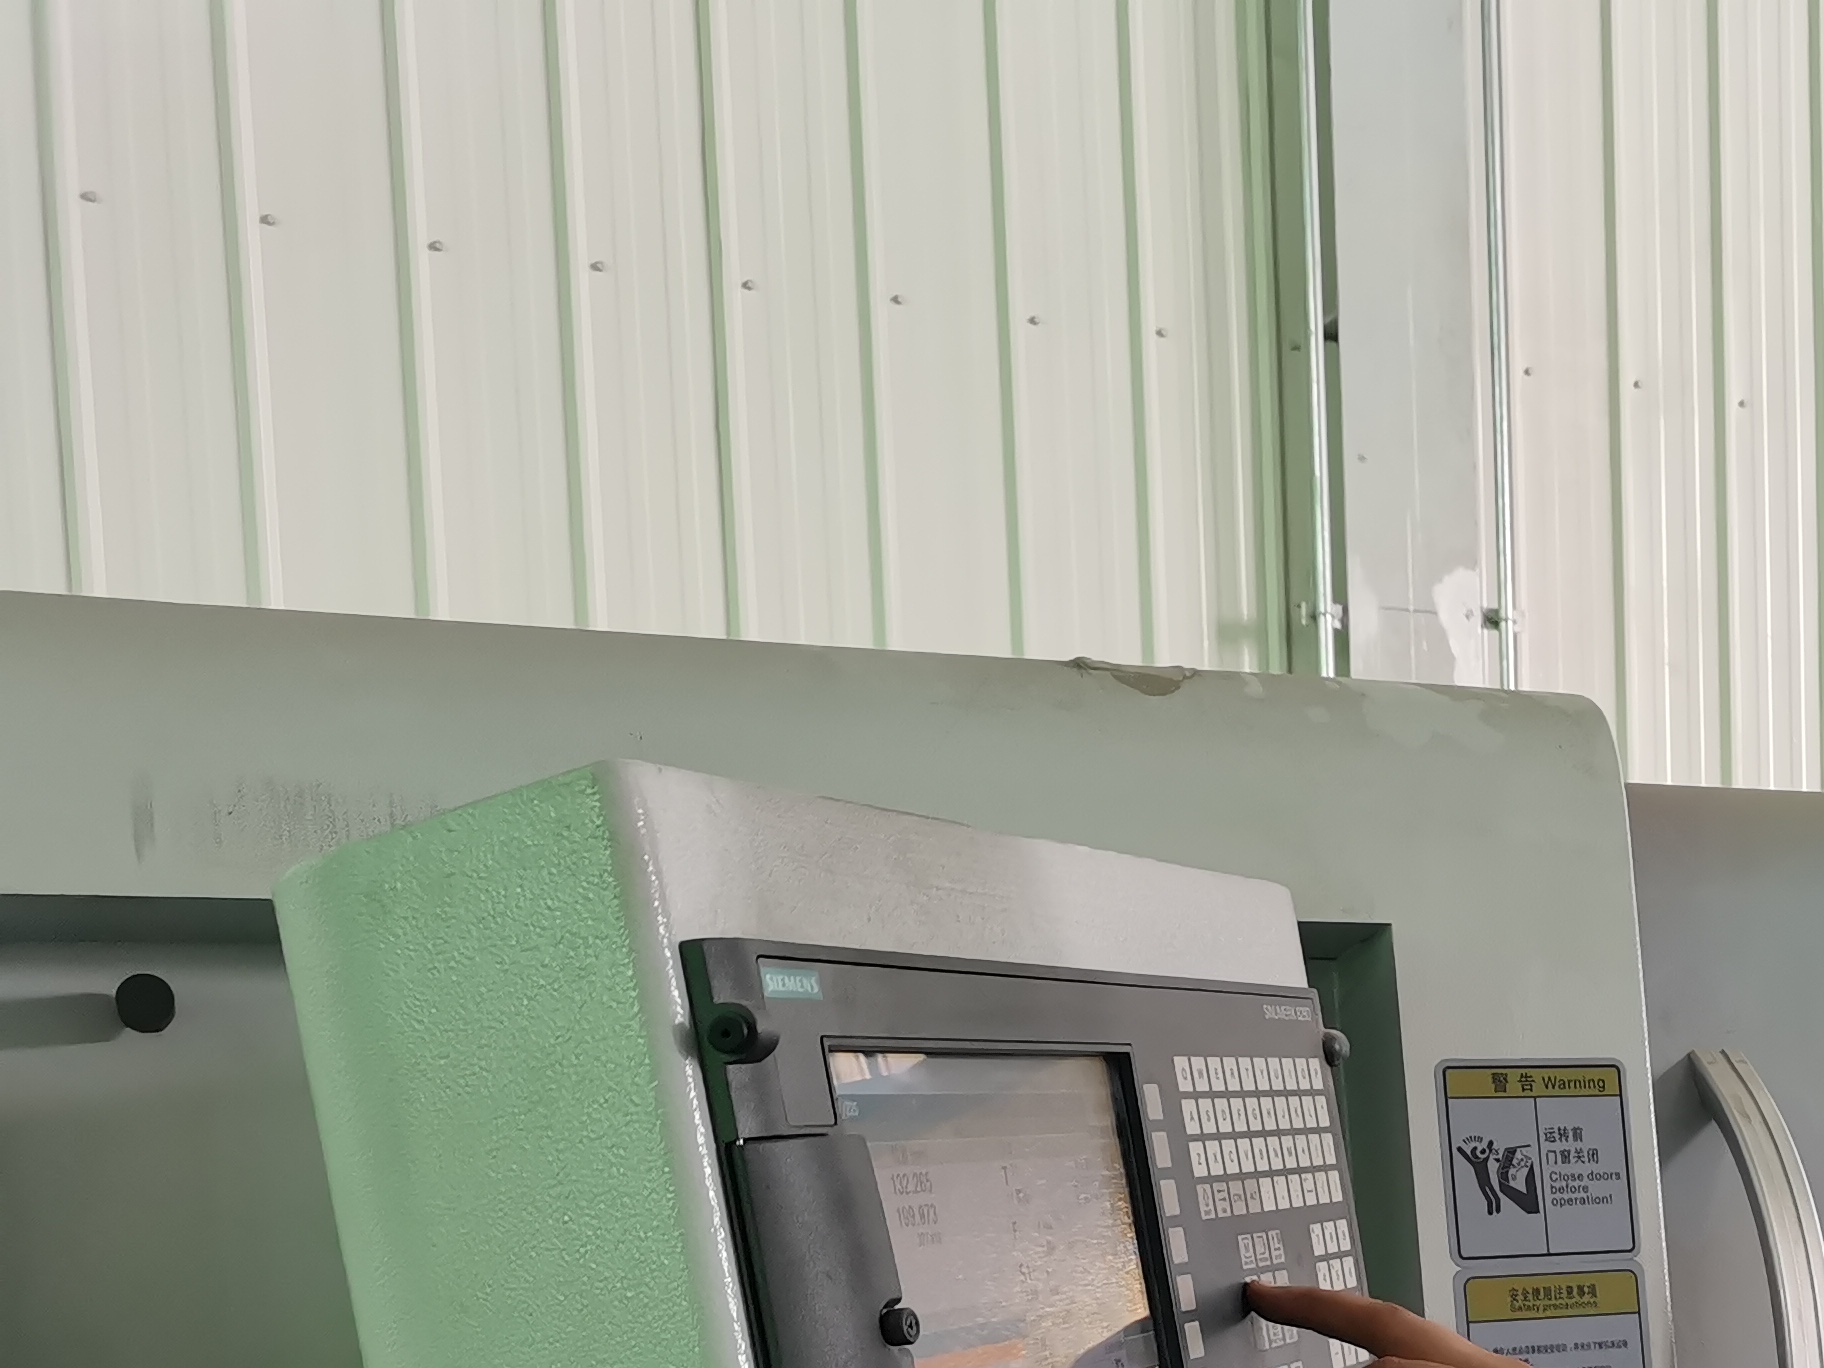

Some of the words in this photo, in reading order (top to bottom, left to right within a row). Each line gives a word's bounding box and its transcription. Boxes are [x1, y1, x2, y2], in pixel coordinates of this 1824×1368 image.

[765, 973, 819, 993] SIEMENS
[1490, 1072, 1536, 1093] 警告
[1541, 1075, 1606, 1092] Warning
[1543, 1126, 1584, 1144] 运转前
[1545, 1148, 1599, 1166] 门窗关闭
[1549, 1171, 1584, 1184] Close
[1587, 1170, 1621, 1181] doors
[1550, 1184, 1589, 1196] before
[1551, 1194, 1613, 1208] operation!
[1509, 1283, 1598, 1303] 安全使用注意事项
[1510, 1302, 1540, 1313] Safety
